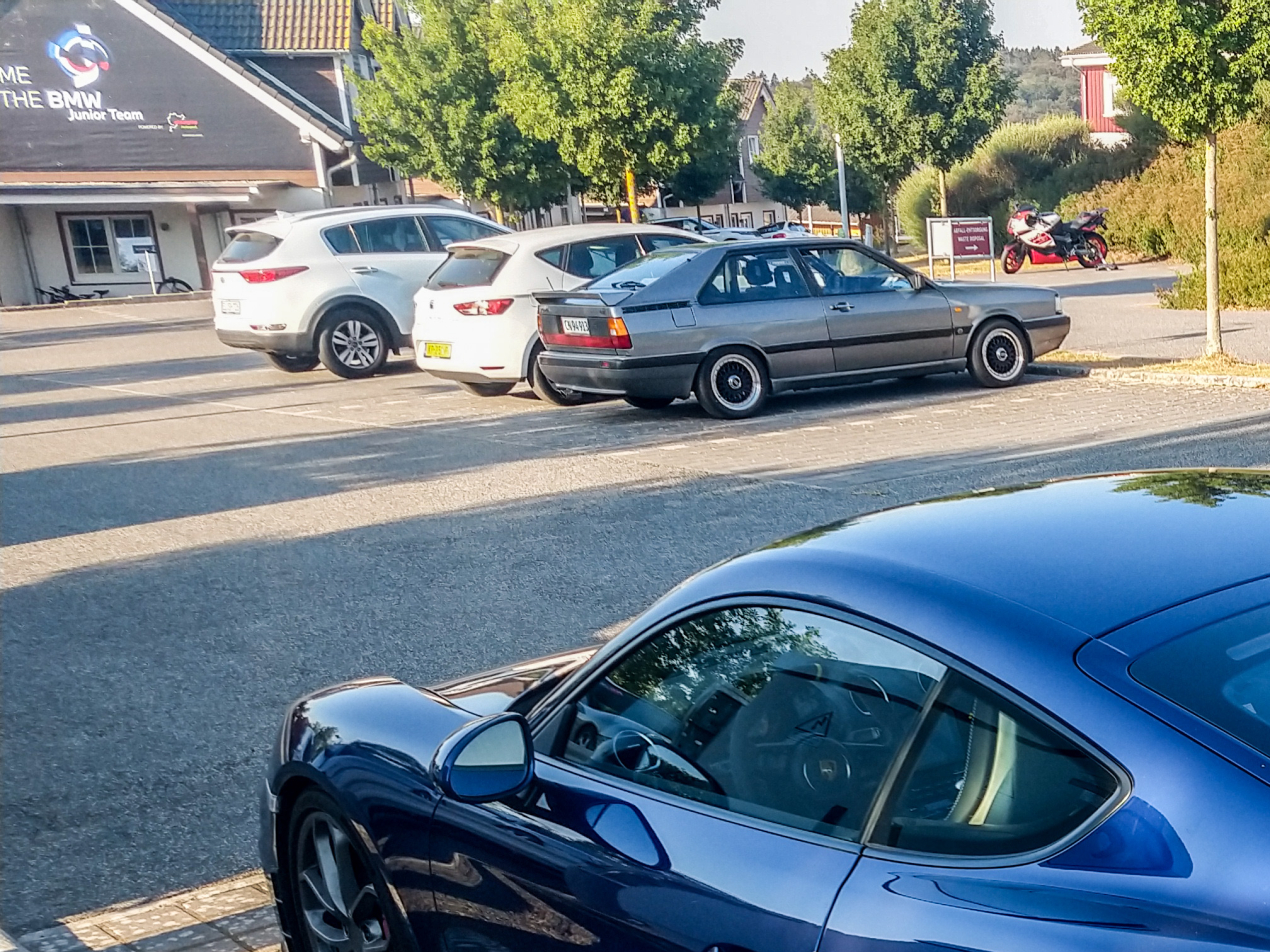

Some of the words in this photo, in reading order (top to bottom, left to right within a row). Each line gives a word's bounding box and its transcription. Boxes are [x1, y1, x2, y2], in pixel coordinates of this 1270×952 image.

[0, 90, 45, 109] THE
[46, 90, 102, 109] BMW
[67, 109, 107, 121] Junior
[107, 108, 144, 120] Team
